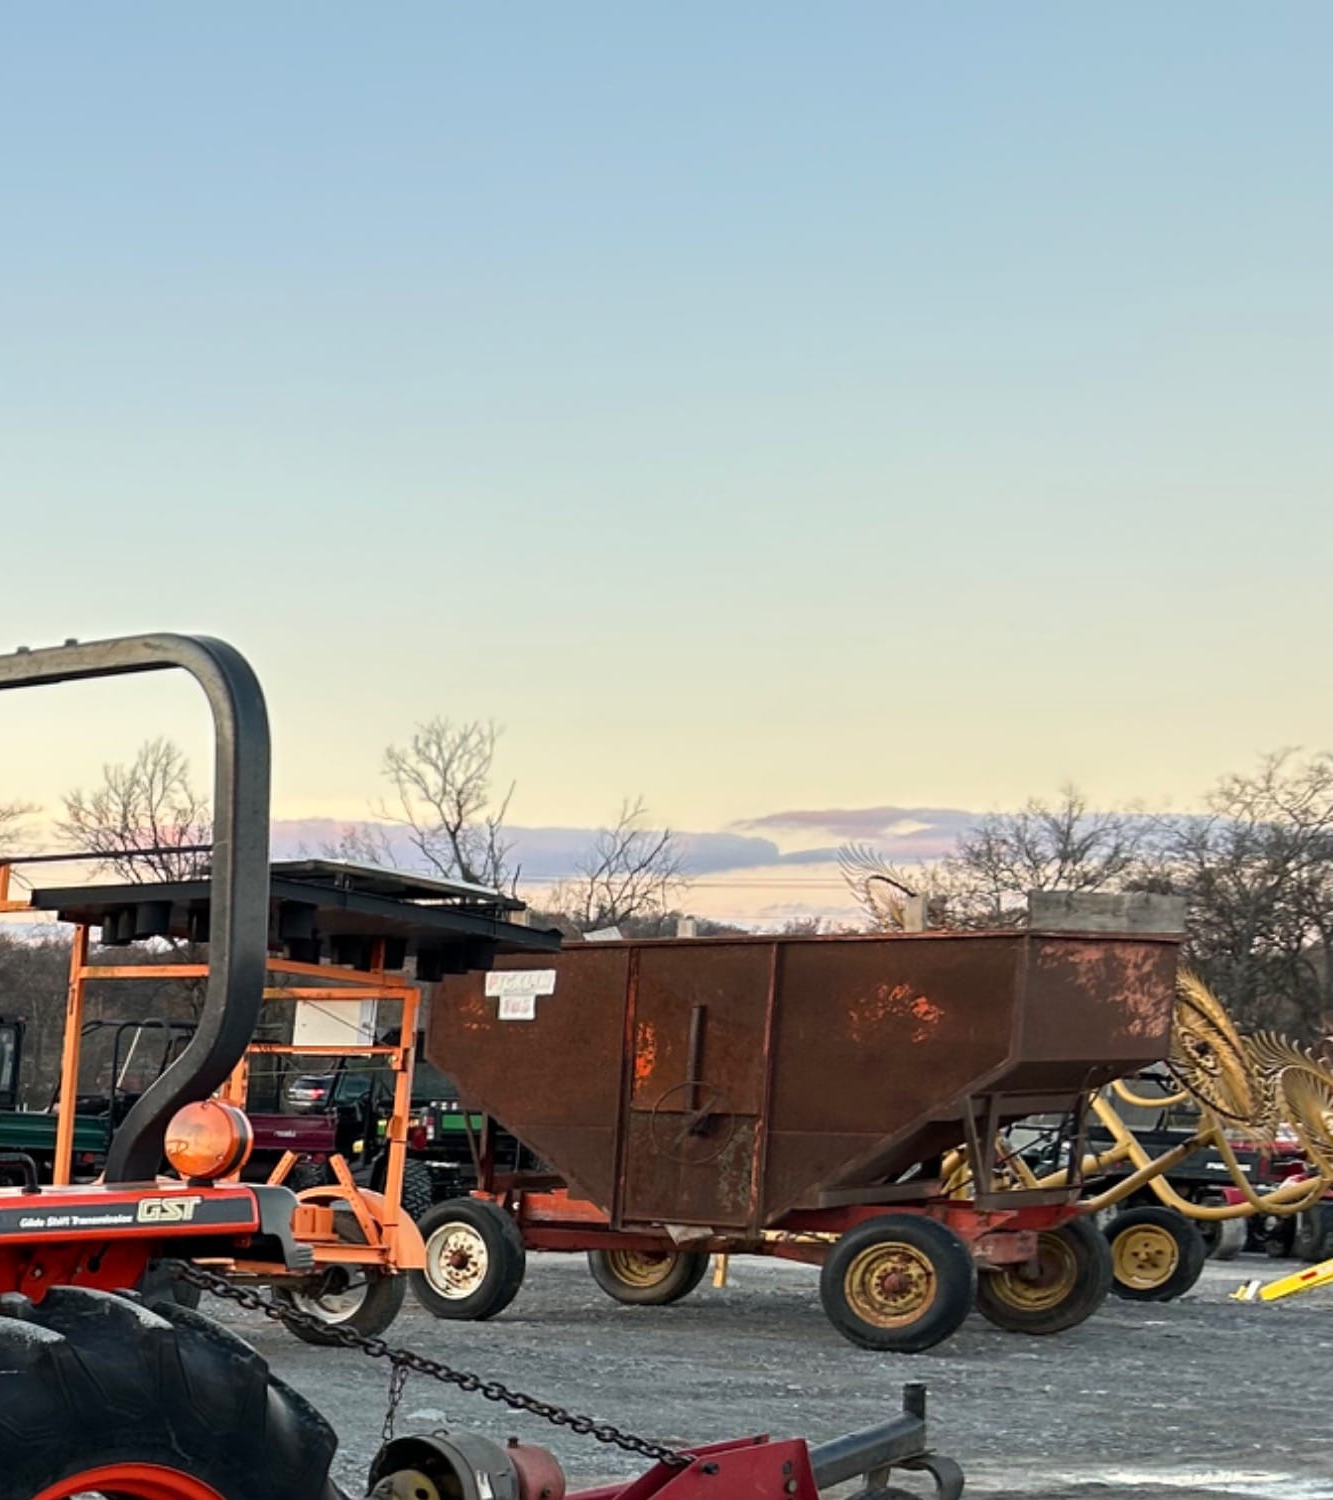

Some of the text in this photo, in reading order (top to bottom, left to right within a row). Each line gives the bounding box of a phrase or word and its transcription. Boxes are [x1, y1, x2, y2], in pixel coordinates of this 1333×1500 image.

[137, 1196, 202, 1223] GST
[20, 1217, 45, 1228] Glide
[47, 1215, 70, 1227] Shift
